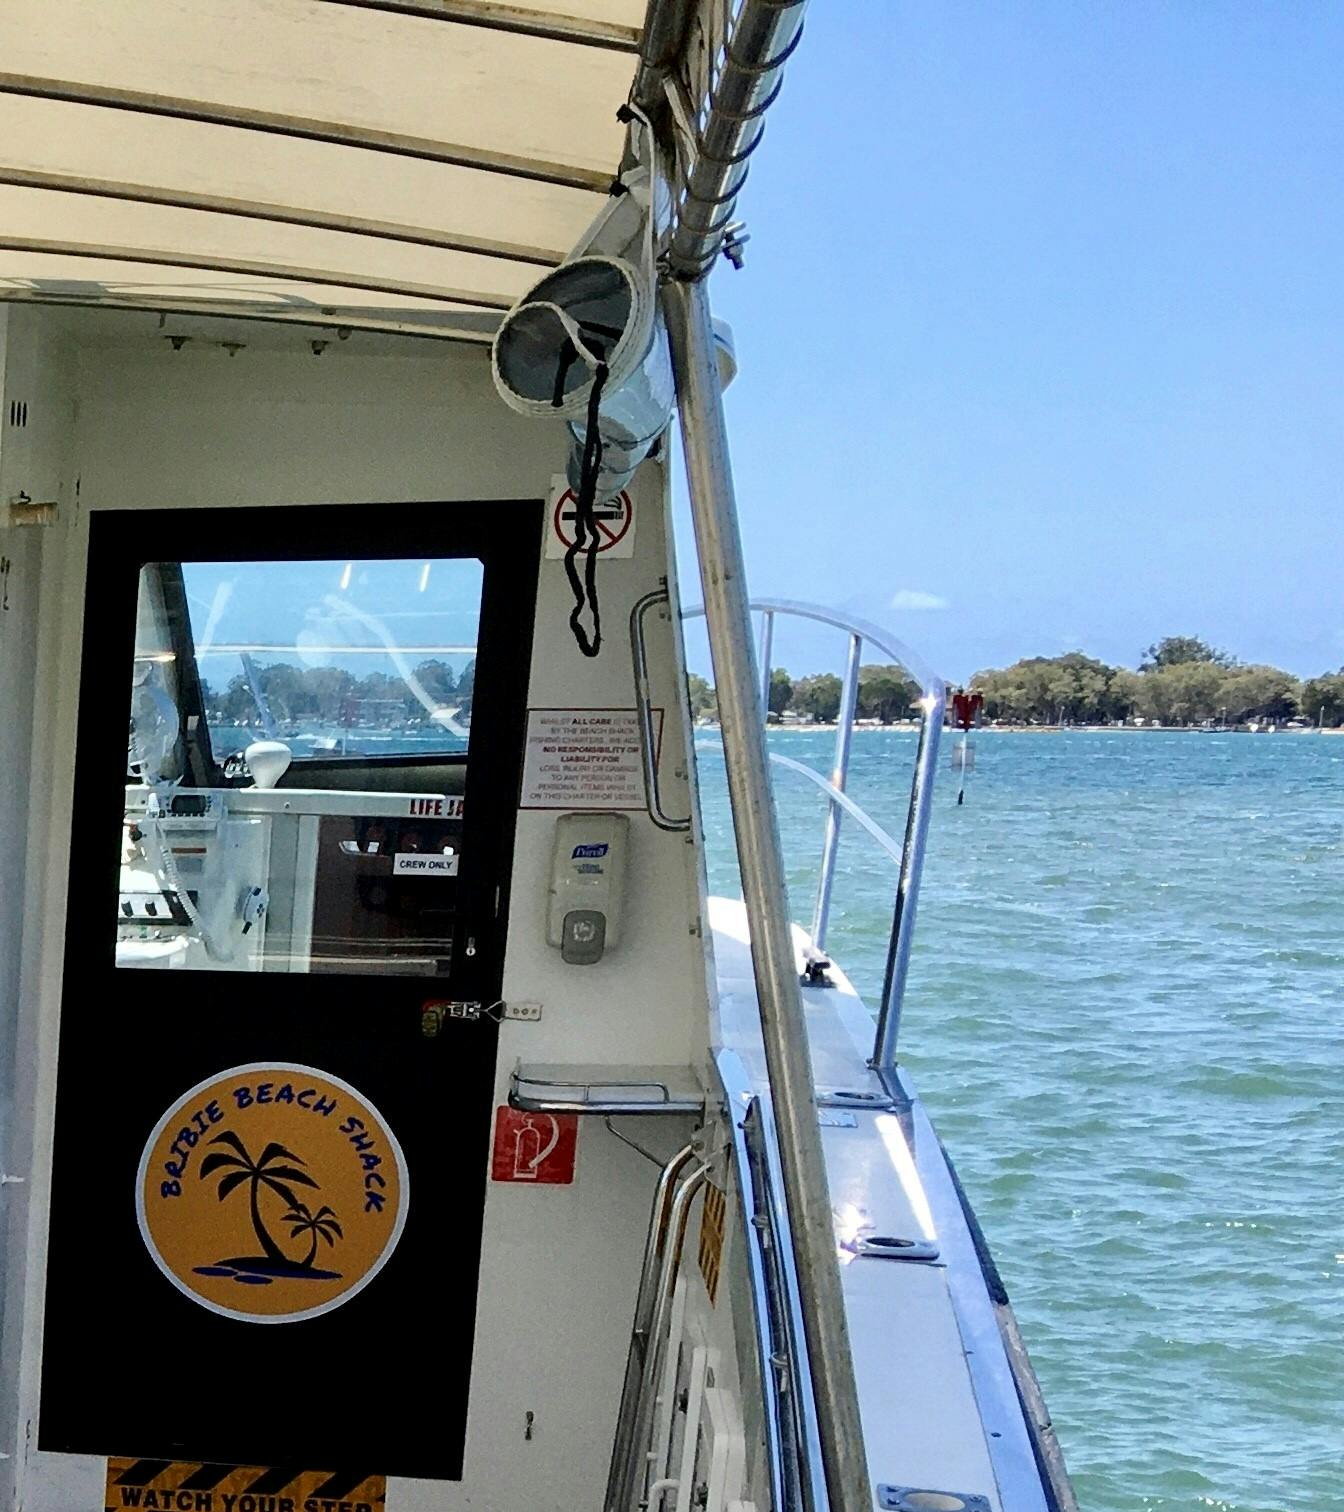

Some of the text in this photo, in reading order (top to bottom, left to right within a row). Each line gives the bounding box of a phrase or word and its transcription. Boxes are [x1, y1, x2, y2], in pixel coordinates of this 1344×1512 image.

[410, 799, 443, 816] LIFE
[400, 860, 453, 869] CREW ONLY
[160, 1083, 387, 1213] BRIBIE BEACH SHACK
[120, 1487, 212, 1512] WATCH
